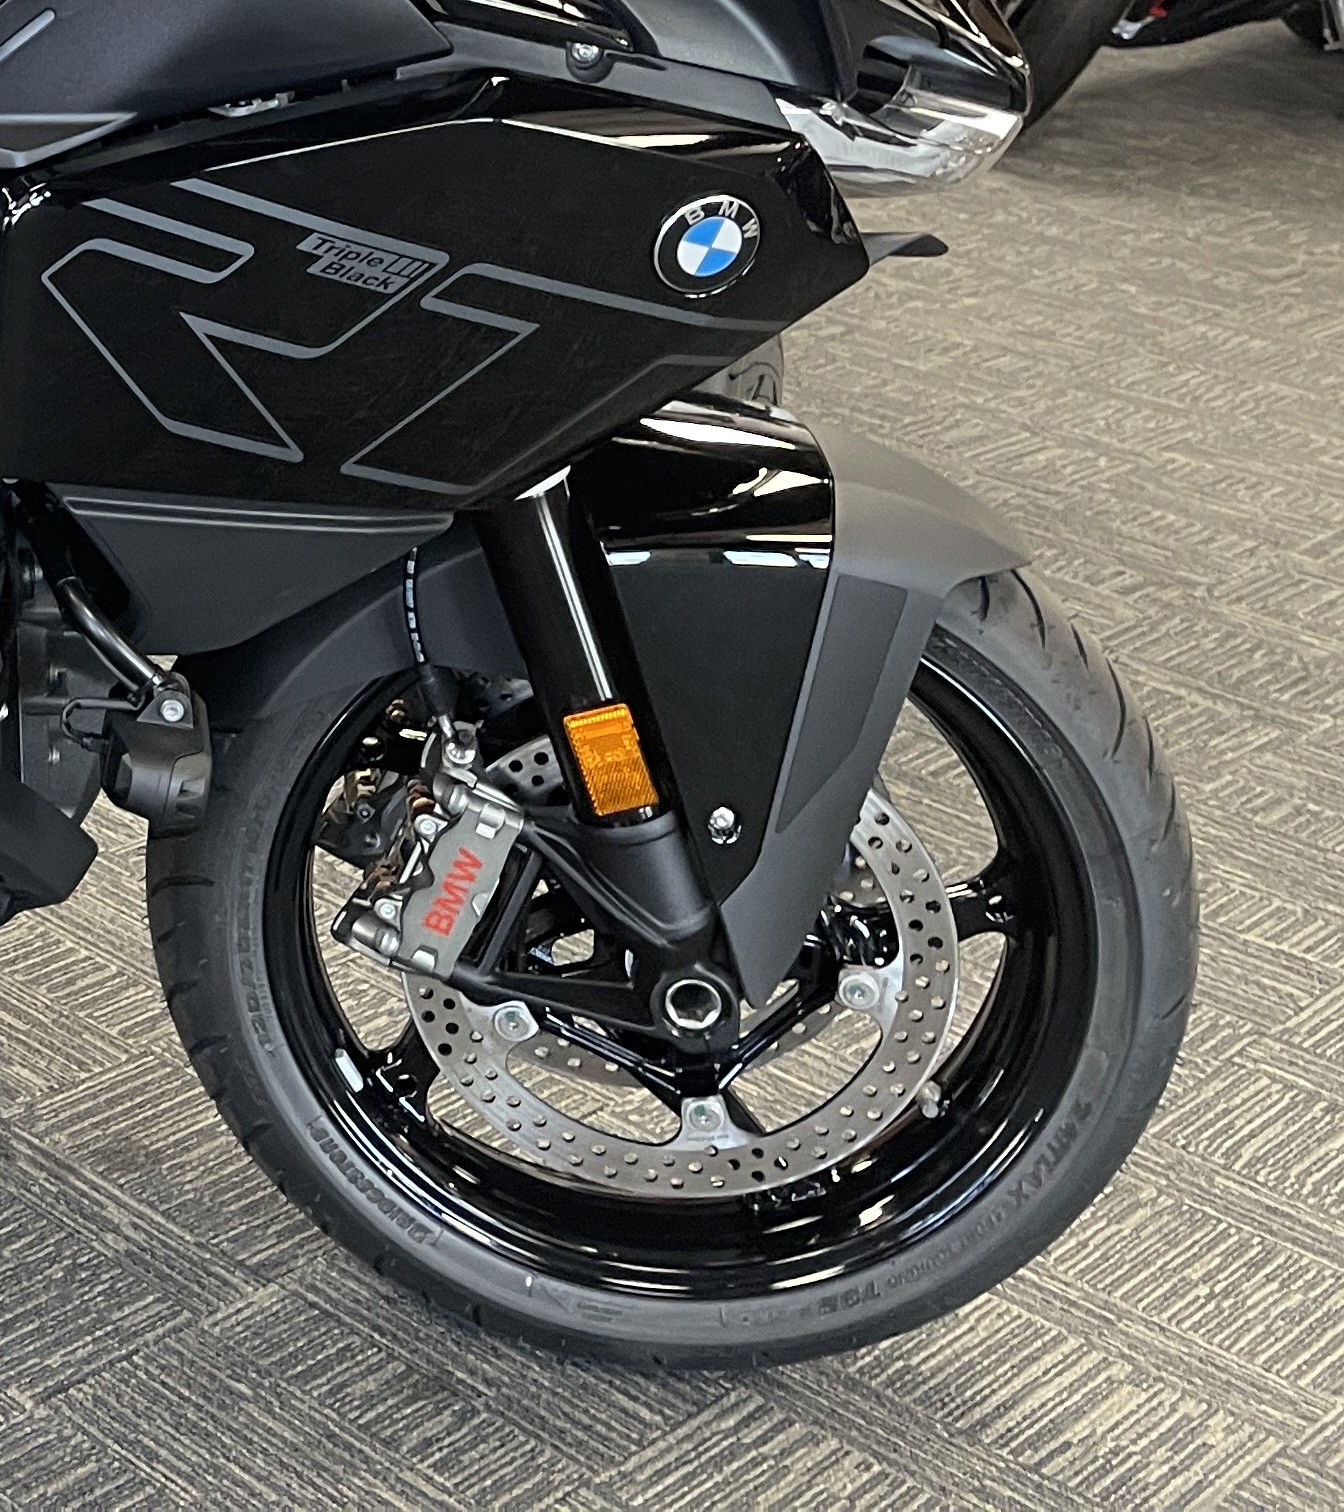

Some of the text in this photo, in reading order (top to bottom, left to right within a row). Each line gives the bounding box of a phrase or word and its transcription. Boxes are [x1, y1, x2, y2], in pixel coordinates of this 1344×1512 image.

[684, 198, 760, 240] BMW
[312, 236, 385, 268] Triple
[319, 261, 397, 291] Black
[422, 846, 484, 937] BMW
